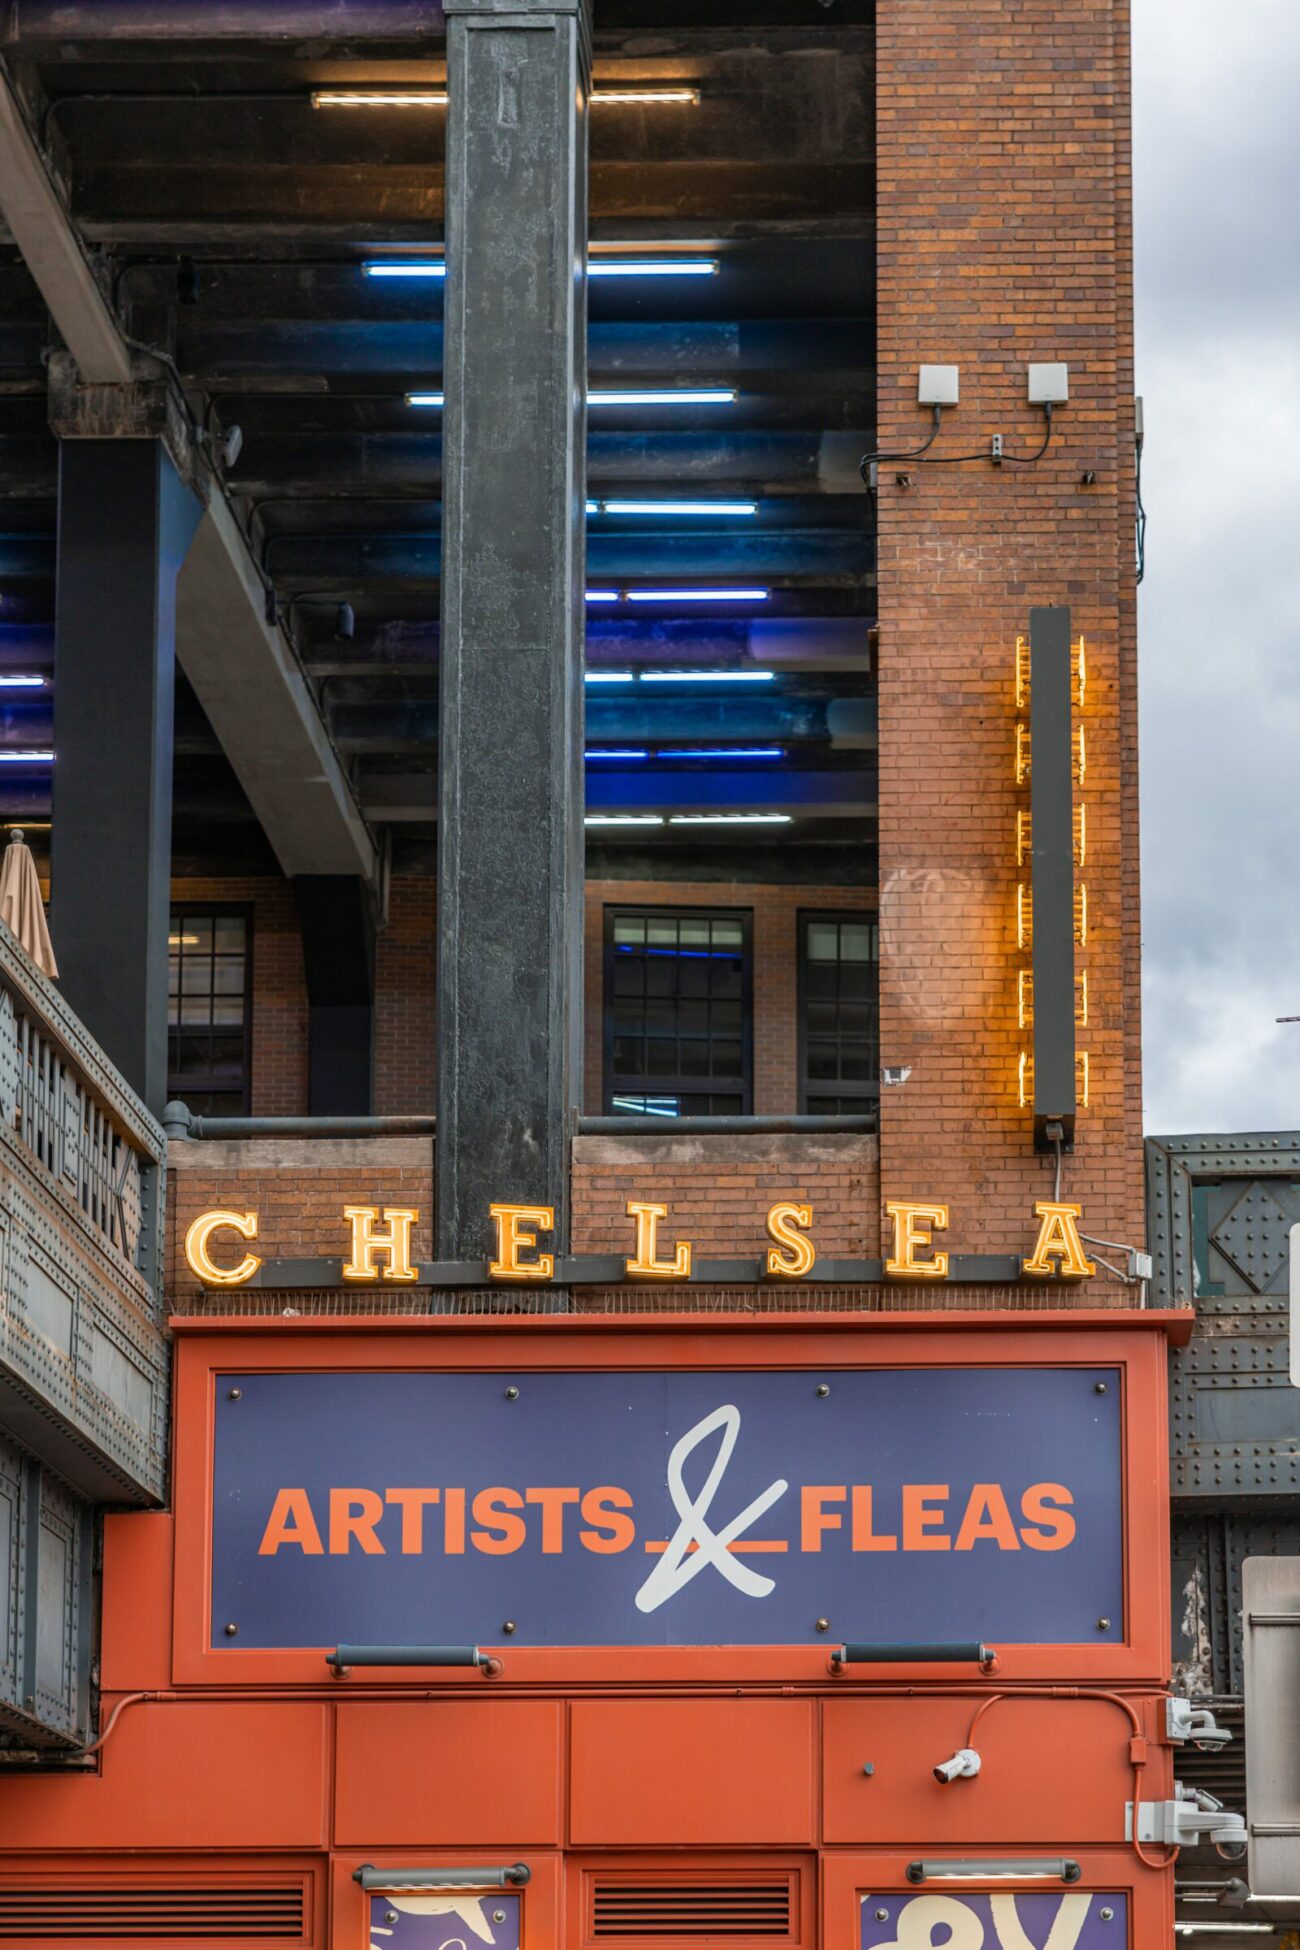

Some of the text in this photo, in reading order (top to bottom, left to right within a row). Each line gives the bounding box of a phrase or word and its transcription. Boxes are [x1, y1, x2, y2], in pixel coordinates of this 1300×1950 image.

[184, 1200, 1097, 1287] CHELSEA
[258, 1404, 1076, 1614] ARTISTS & FLEAS
